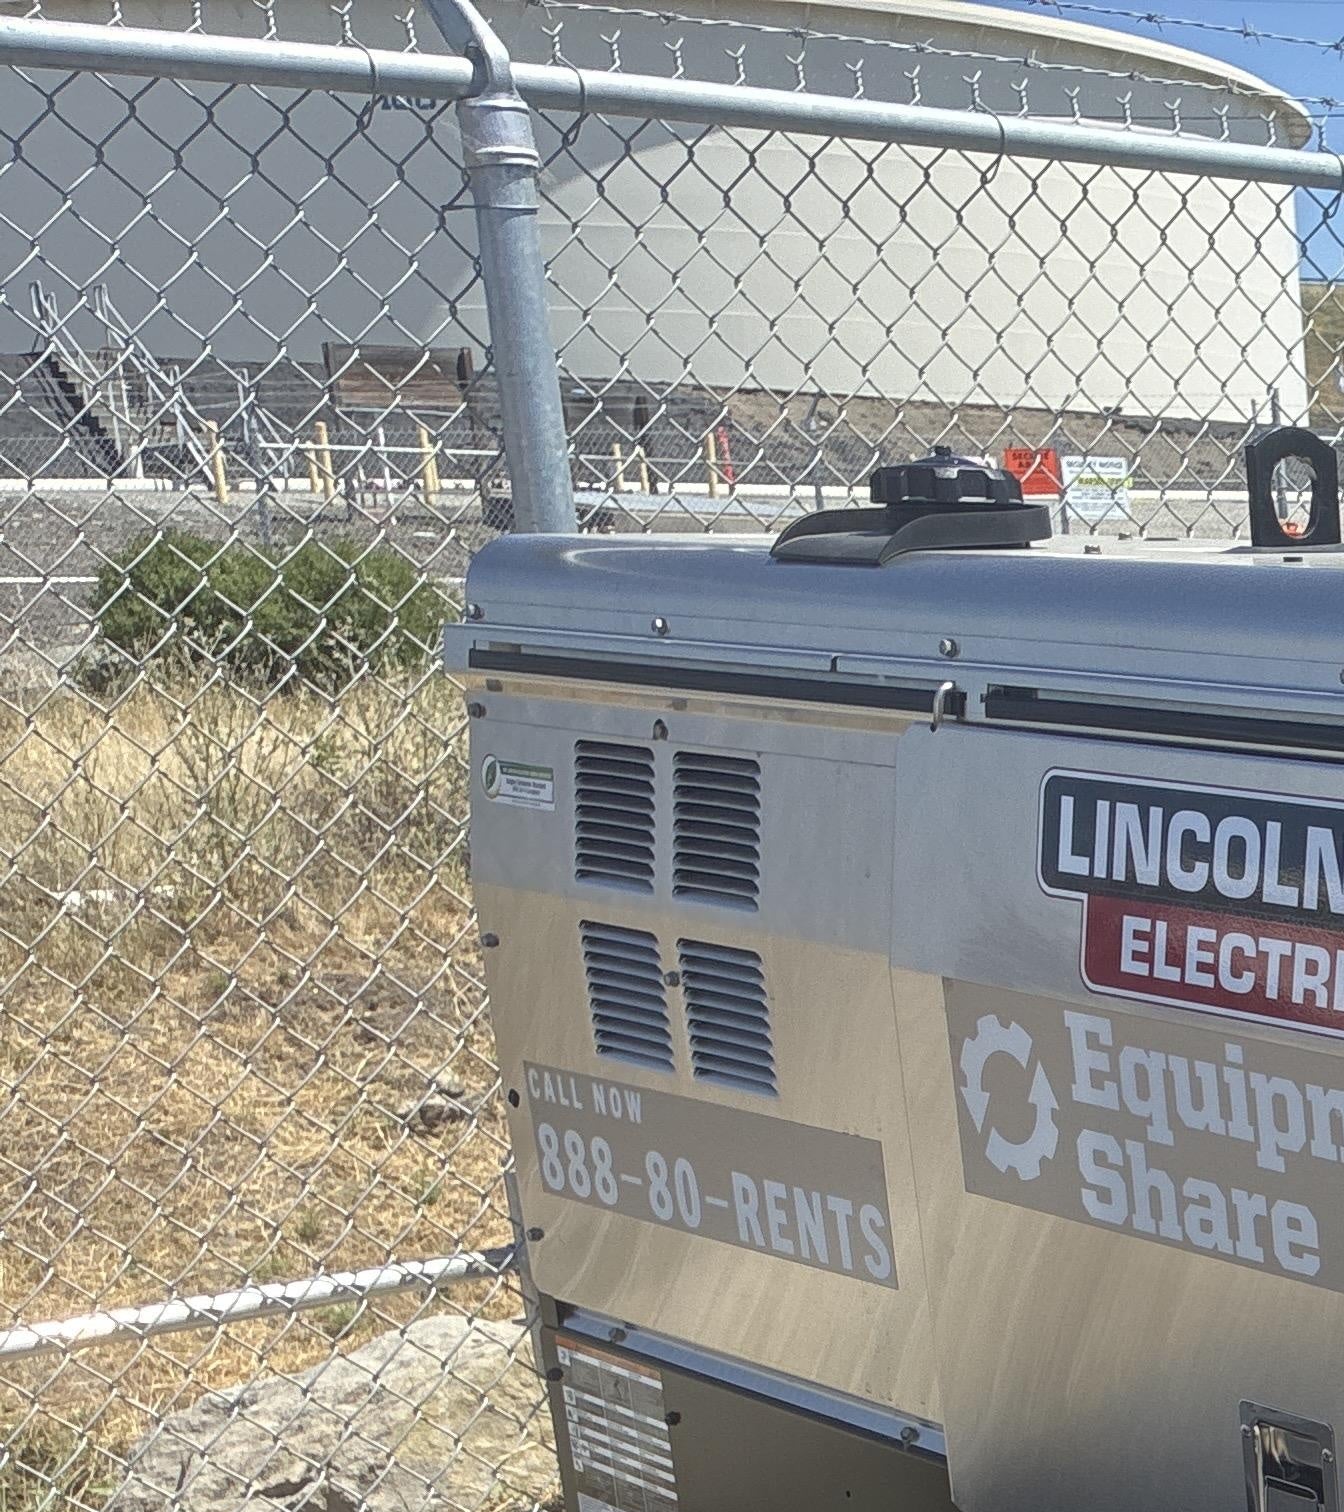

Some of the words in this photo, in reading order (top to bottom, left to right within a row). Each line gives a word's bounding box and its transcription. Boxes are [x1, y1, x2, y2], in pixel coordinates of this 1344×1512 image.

[528, 1067, 584, 1110] CALL
[593, 1081, 642, 1124] NOW
[537, 1122, 893, 1280] 888-80-RENTS
[1076, 1128, 1321, 1277] Share
